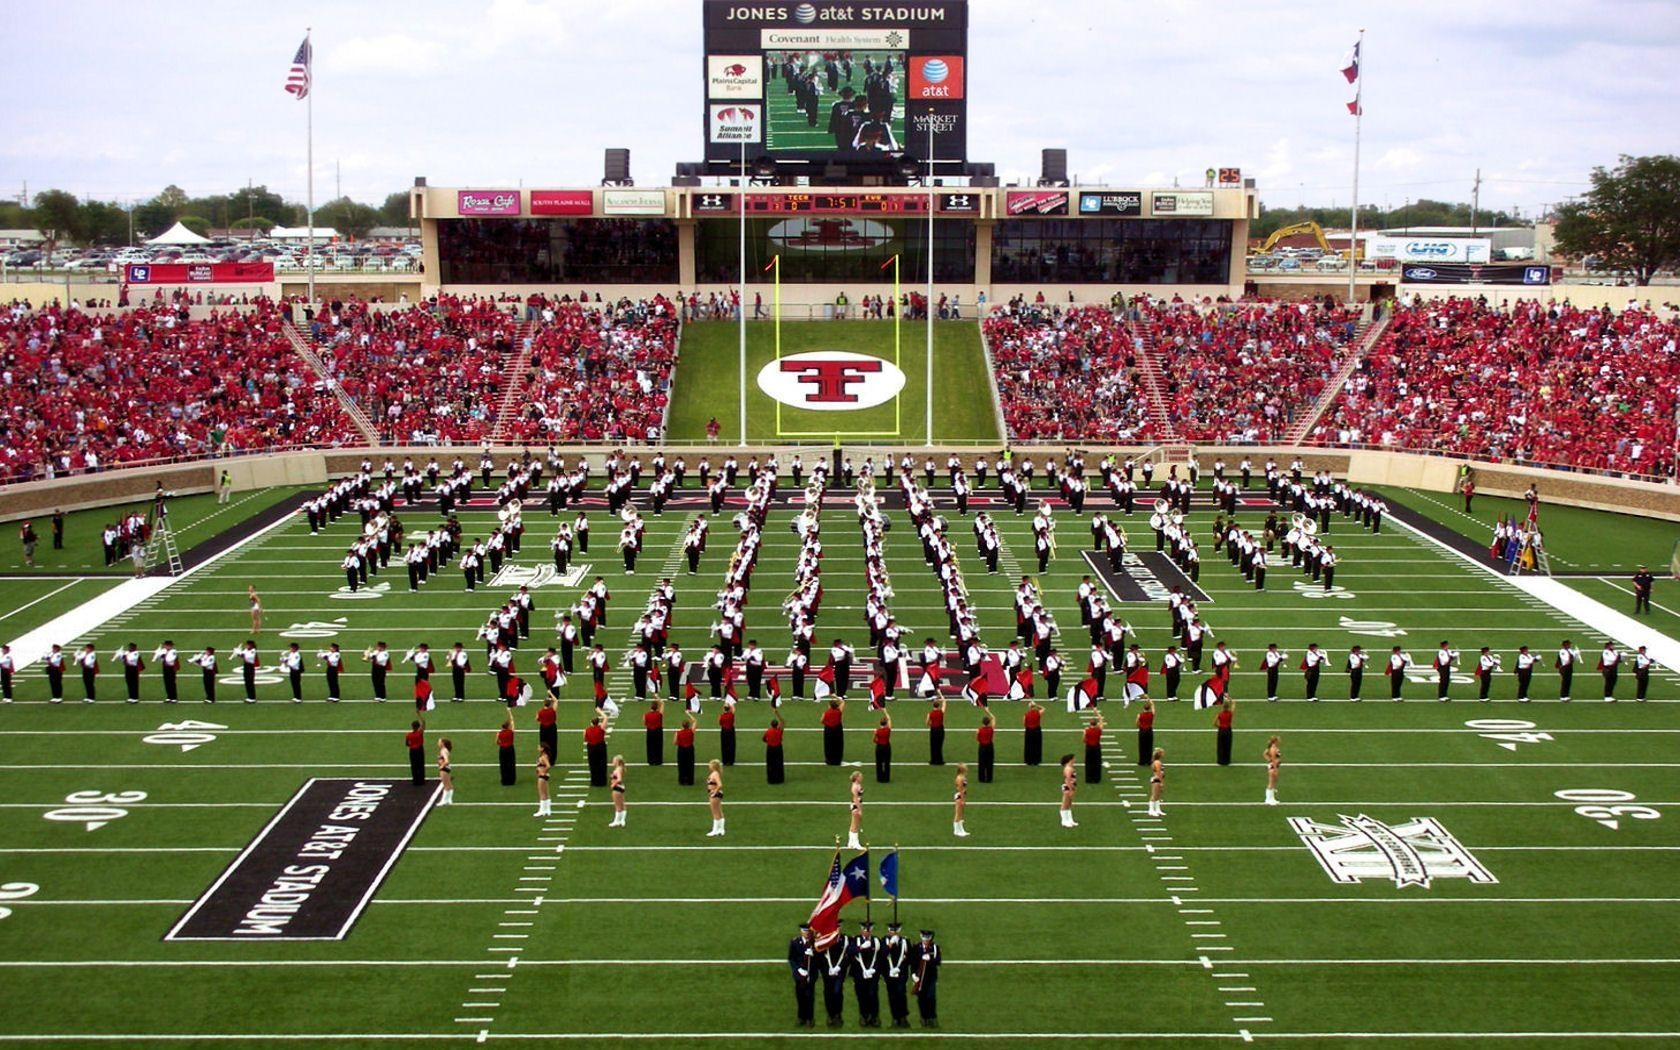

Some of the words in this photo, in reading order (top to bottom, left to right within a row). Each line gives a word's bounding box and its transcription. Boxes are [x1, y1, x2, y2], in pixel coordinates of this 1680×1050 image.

[726, 7, 788, 20] JONES
[820, 6, 854, 21] at&t
[861, 7, 945, 20] STADIUM
[768, 34, 820, 44] Covenant
[825, 35, 851, 44] Health
[853, 35, 882, 45] System
[922, 85, 949, 97] at&t
[913, 114, 959, 123] MARKET
[916, 123, 955, 133] STREET
[1220, 168, 1240, 183] 25
[827, 197, 856, 209] 7:51
[43, 790, 149, 823] 30
[327, 781, 393, 821] JONES
[1553, 788, 1662, 820] 30
[297, 823, 361, 860] AT&T
[232, 864, 331, 934] STADIUM
